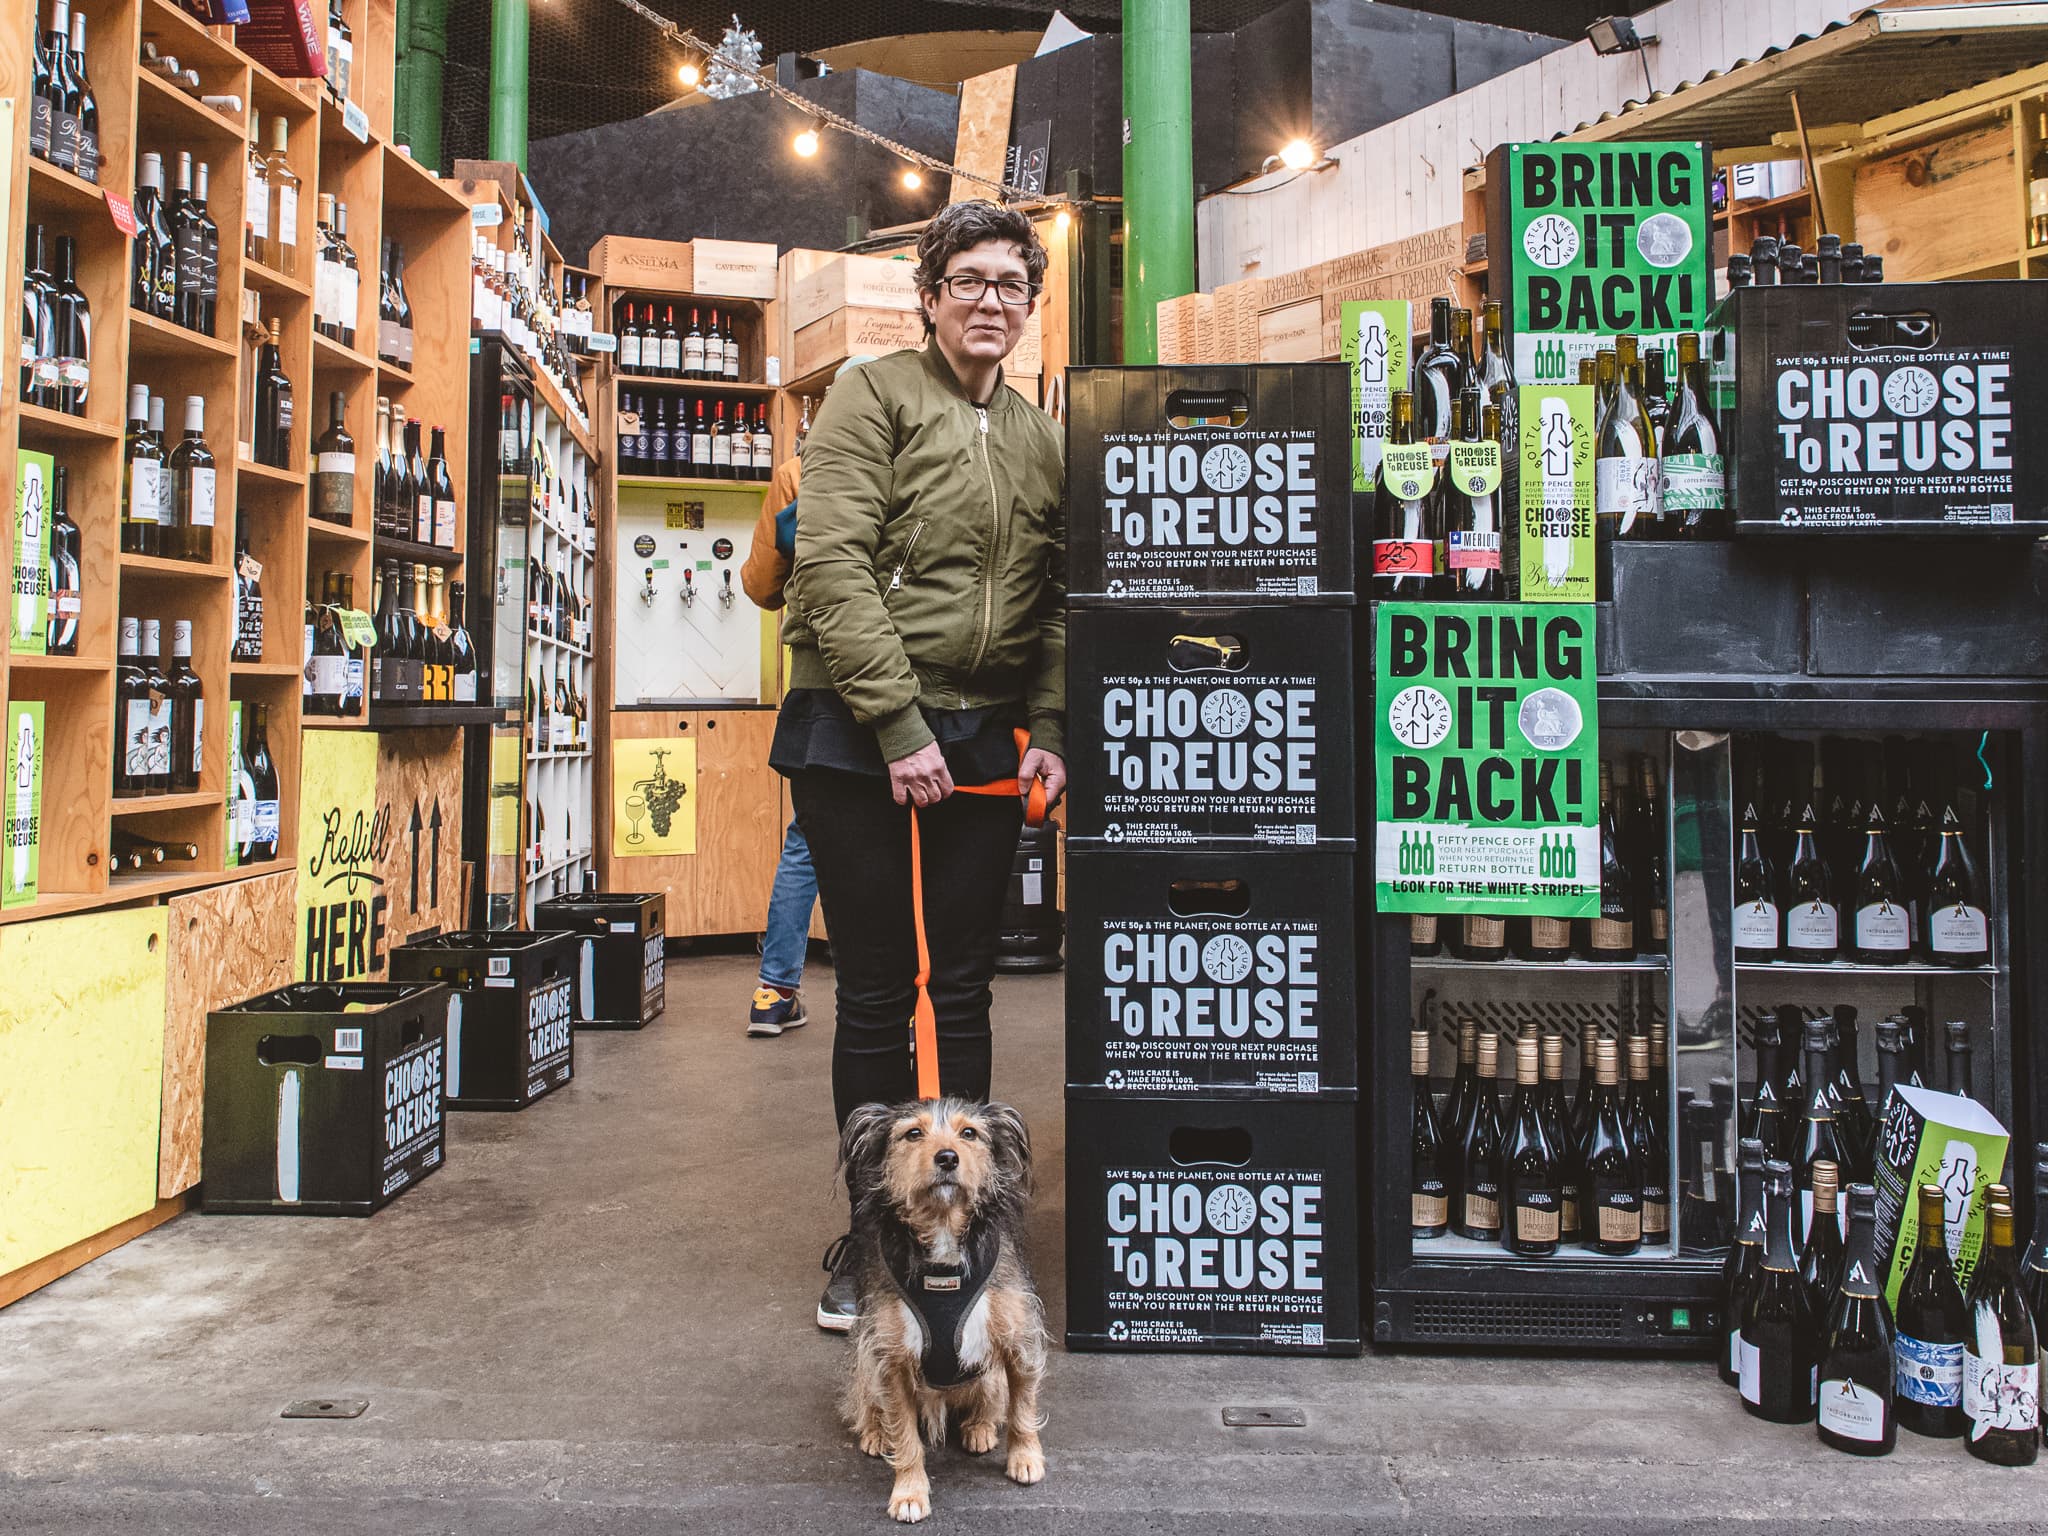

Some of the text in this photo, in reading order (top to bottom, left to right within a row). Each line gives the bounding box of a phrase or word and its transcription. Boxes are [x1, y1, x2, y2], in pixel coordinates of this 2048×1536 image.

[1523, 152, 1692, 208] BRING
[1399, 232, 1438, 255] TAPADA
[1527, 221, 1575, 261] BOTTLE RETURN
[1584, 214, 1635, 269] IT
[620, 255, 679, 270] ANSELMA
[1528, 274, 1693, 330] BACK!
[1383, 329, 1403, 376] RETURN
[1777, 364, 2011, 420] CHOOSE
[1889, 372, 1935, 410] BOTTLE RETURN
[1358, 426, 1392, 438] REUS
[1455, 447, 1497, 457] CHOOSE
[1525, 417, 1590, 468] BOTTLE RETURN
[1828, 419, 2013, 473] REUSE
[1105, 443, 1315, 495] CHOOSE
[1204, 450, 1248, 486] BOTTLE RETURN
[1386, 452, 1428, 462] CHOOSE
[1396, 461, 1429, 471] REUSE
[1464, 457, 1497, 467] REUSE
[1152, 495, 1318, 546] REUSE
[1525, 508, 1590, 522] CHOOSE
[1540, 524, 1590, 537] REUSE
[1463, 532, 1495, 547] MERLOT
[12, 566, 47, 582] HOOSE
[16, 581, 46, 596] REUSE
[1390, 614, 1583, 680] BRING
[1103, 677, 1126, 685] SAVE
[1128, 677, 1143, 687] 50p
[1154, 677, 1170, 685] THE
[1173, 677, 1209, 686] PLANET,
[1210, 677, 1230, 685] ONE
[1234, 677, 1266, 685] BOTTLE
[1268, 677, 1281, 685] AT
[1282, 677, 1289, 685] A
[1291, 677, 1316, 685] TIME!
[1103, 688, 1316, 738] CHOOSE
[1204, 694, 1247, 731] BOTTLE RETURN
[1392, 692, 1448, 739] BOTTLE RETURN
[1457, 686, 1517, 750] IT
[1150, 741, 1316, 791] REUSE
[1104, 805, 1316, 813] WHEN YOU RETURN THE RETURN BOTTLE
[1105, 796, 1315, 806] GET 50p DISCOUNT ON YOUR NEXT PURCHASE
[1392, 756, 1583, 823] BACK!
[6, 817, 39, 833] CHOOSE
[13, 832, 38, 847] REUSE
[1437, 836, 1536, 846] FIFTY PENCE OFF
[310, 802, 391, 895] Refill
[1392, 880, 1584, 897] LOOK FOR THE WHITE STRIPE!
[1439, 864, 1534, 875] RETURN BOTTLE
[305, 896, 388, 981] HERE
[1104, 933, 1318, 985] CHOOSE
[1205, 940, 1249, 976] BOTTLE RETURN
[529, 984, 570, 1028] CHOOSE
[1151, 987, 1318, 1038] REUSE
[538, 1016, 570, 1058] REUSE
[385, 1046, 441, 1111] CHOOSE
[397, 1085, 440, 1146] REUSE
[1901, 1115, 1915, 1166] RETURN
[1107, 1182, 1322, 1236] CHOOSE
[1209, 1190, 1253, 1227] BOTTLE RETURN
[1155, 1238, 1322, 1290] REUSE
